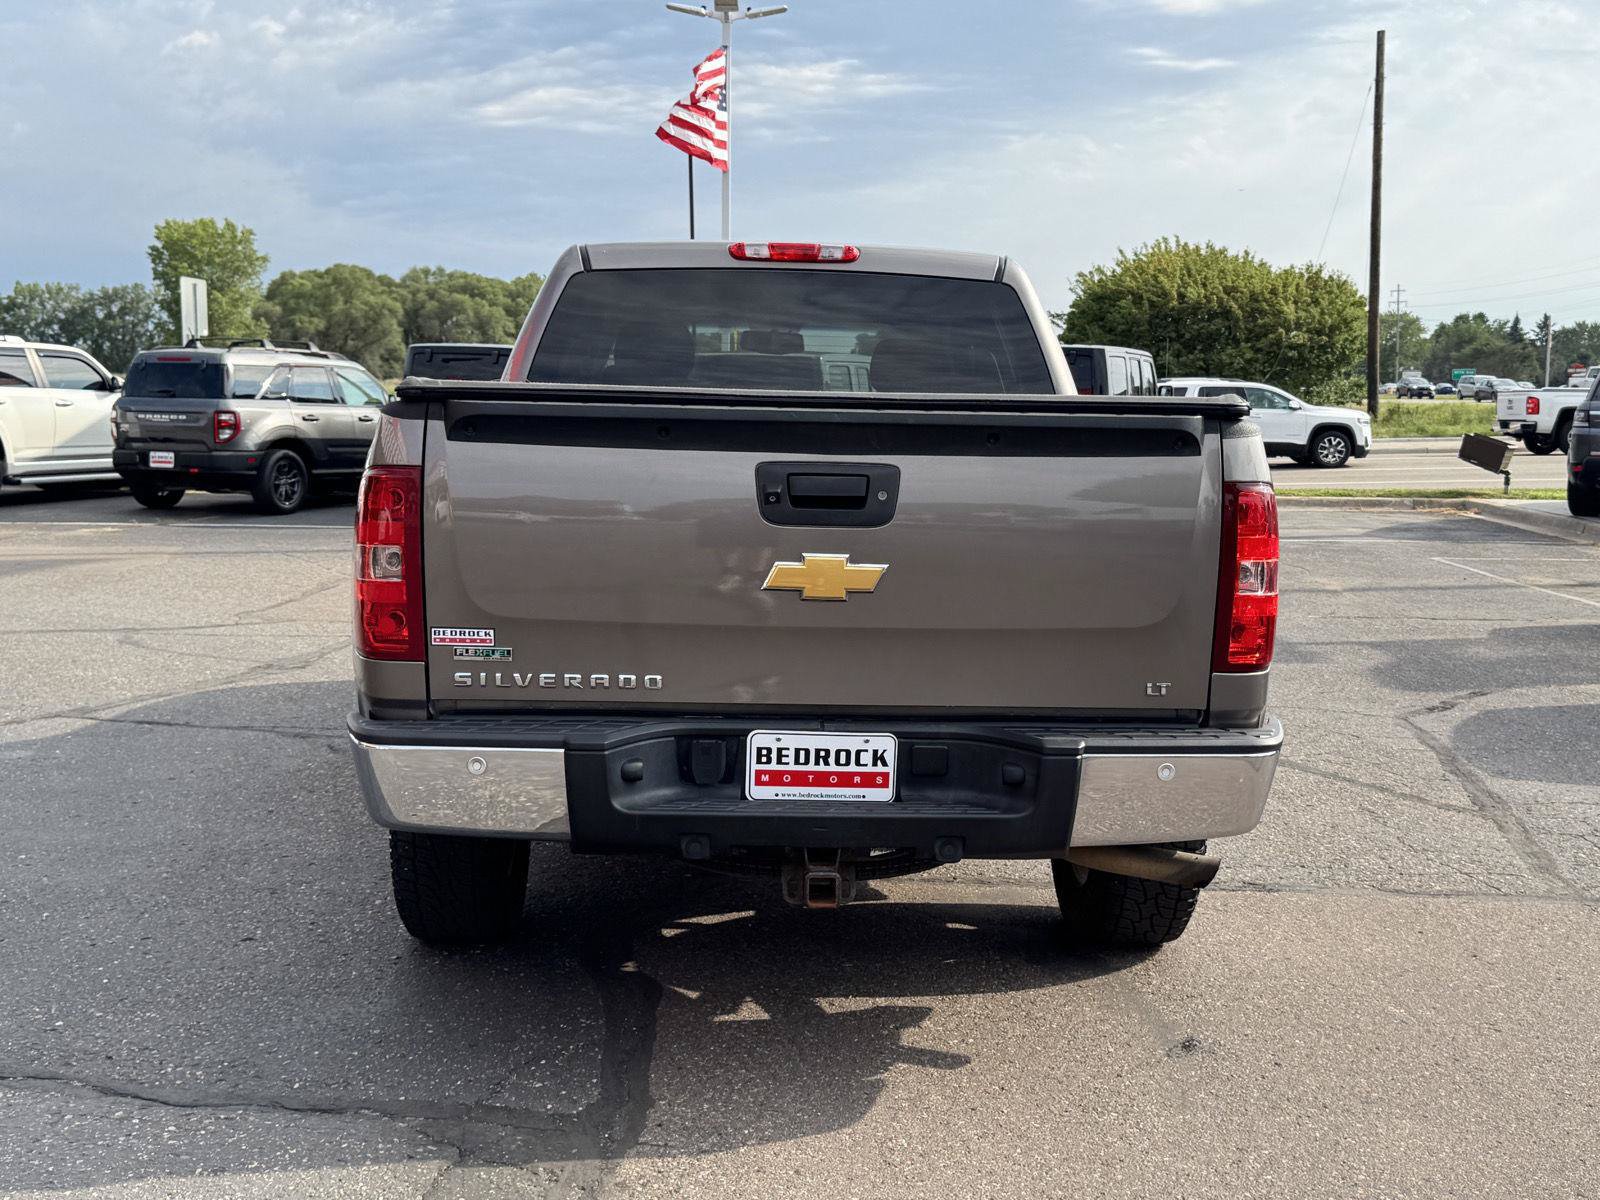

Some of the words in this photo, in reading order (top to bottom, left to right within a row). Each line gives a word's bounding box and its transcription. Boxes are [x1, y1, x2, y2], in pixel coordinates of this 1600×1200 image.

[433, 629, 492, 637] BEDROCK
[453, 672, 663, 690] SILVERADO
[1146, 682, 1172, 696] LT
[755, 746, 890, 768] BEDROCK
[761, 774, 884, 784] MOTORS
[781, 791, 862, 800] www.bedrockmotors.com
